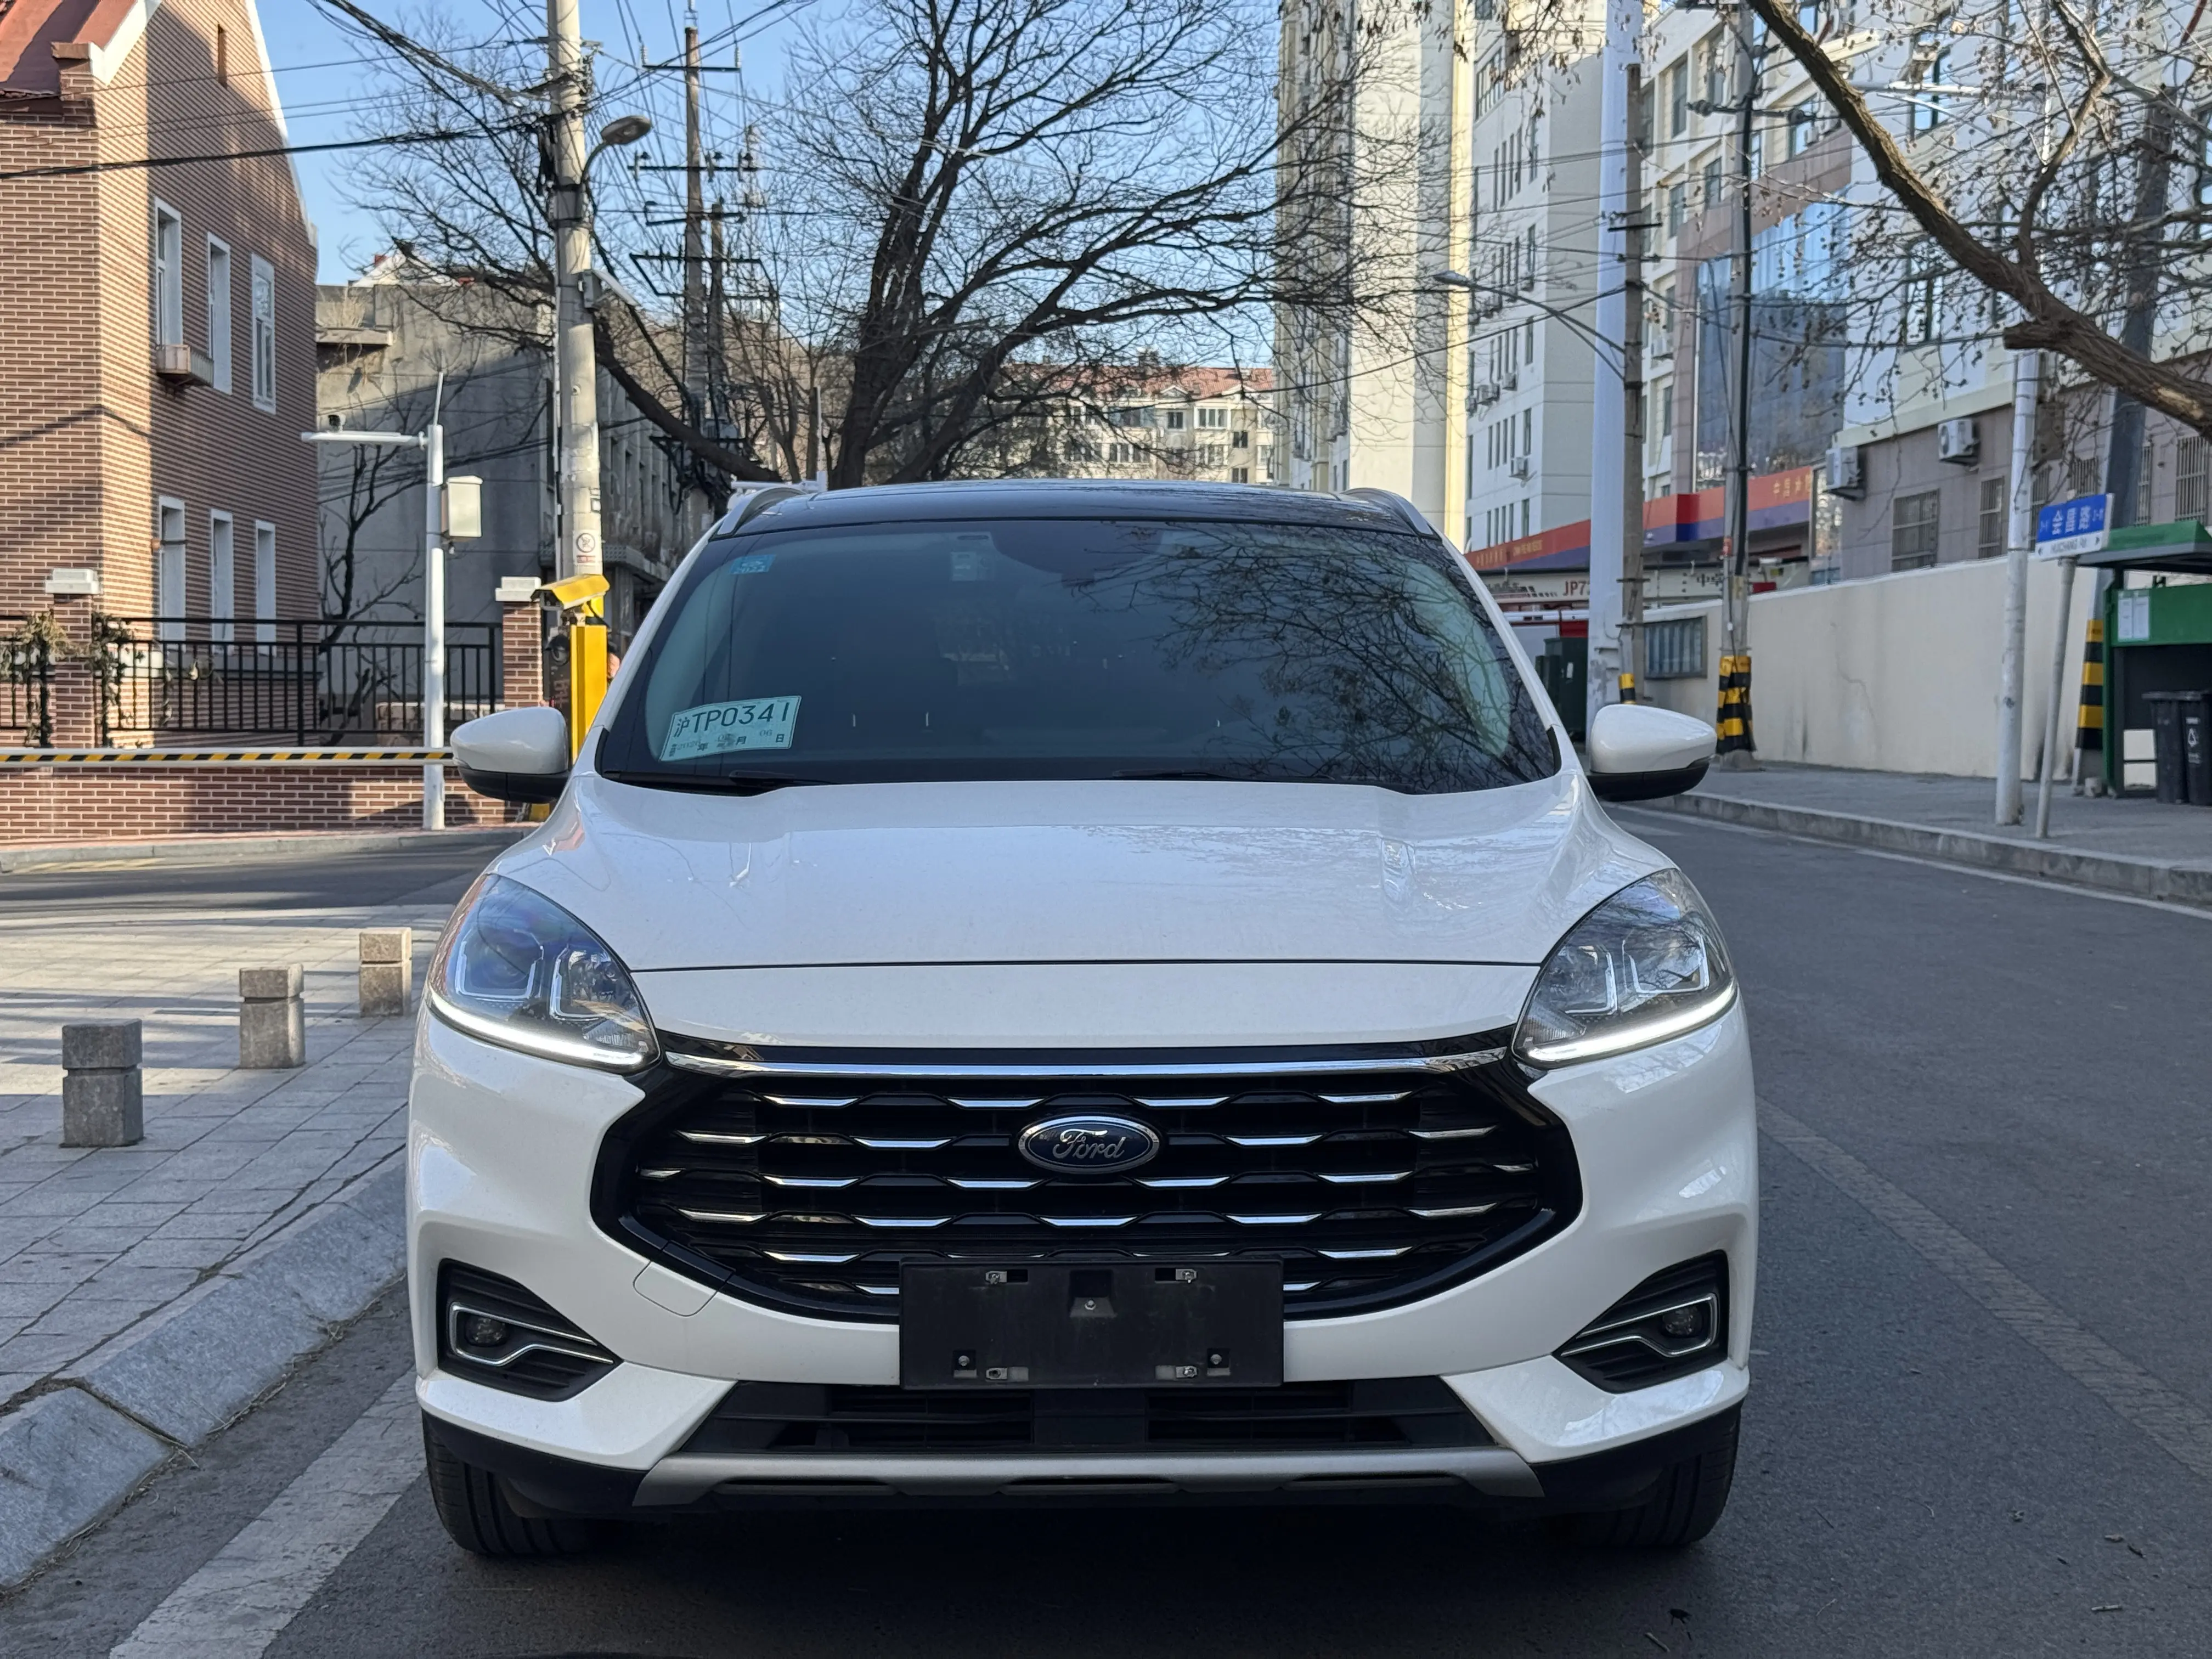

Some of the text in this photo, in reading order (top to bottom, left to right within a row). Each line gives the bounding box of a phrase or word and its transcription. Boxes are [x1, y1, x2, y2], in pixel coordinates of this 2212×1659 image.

[1562, 580, 1590, 596] JP7
[673, 702, 790, 738] 沪TP0341
[775, 733, 785, 743] 日
[1052, 1128, 1126, 1159] Ford
